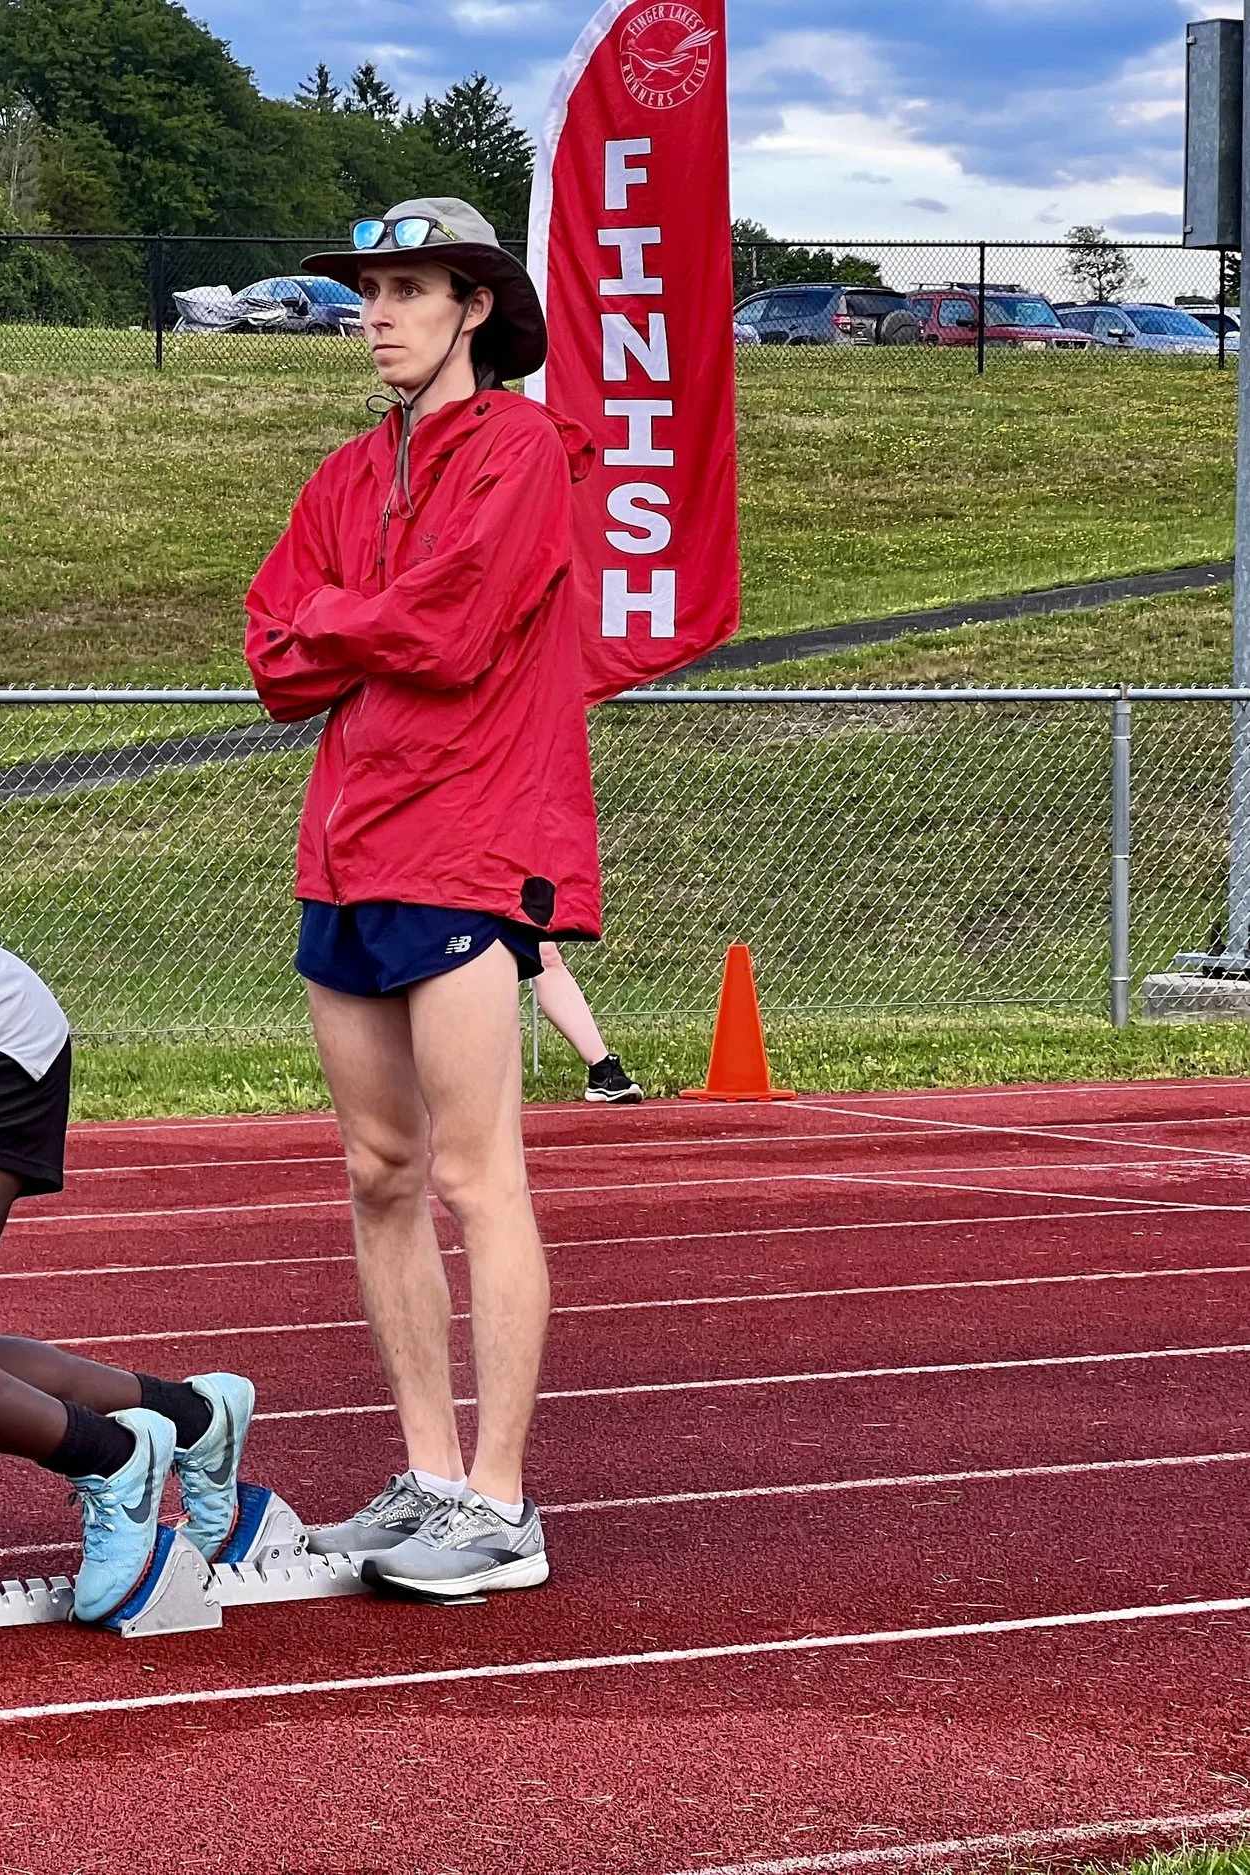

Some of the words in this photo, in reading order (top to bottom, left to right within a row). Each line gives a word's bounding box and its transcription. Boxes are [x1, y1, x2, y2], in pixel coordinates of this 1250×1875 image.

[627, 6, 664, 35] FINGER
[670, 6, 701, 29] LAKES
[622, 64, 673, 106] RUNNERS
[682, 59, 707, 94] CLUB
[598, 138, 678, 639] FINISH
